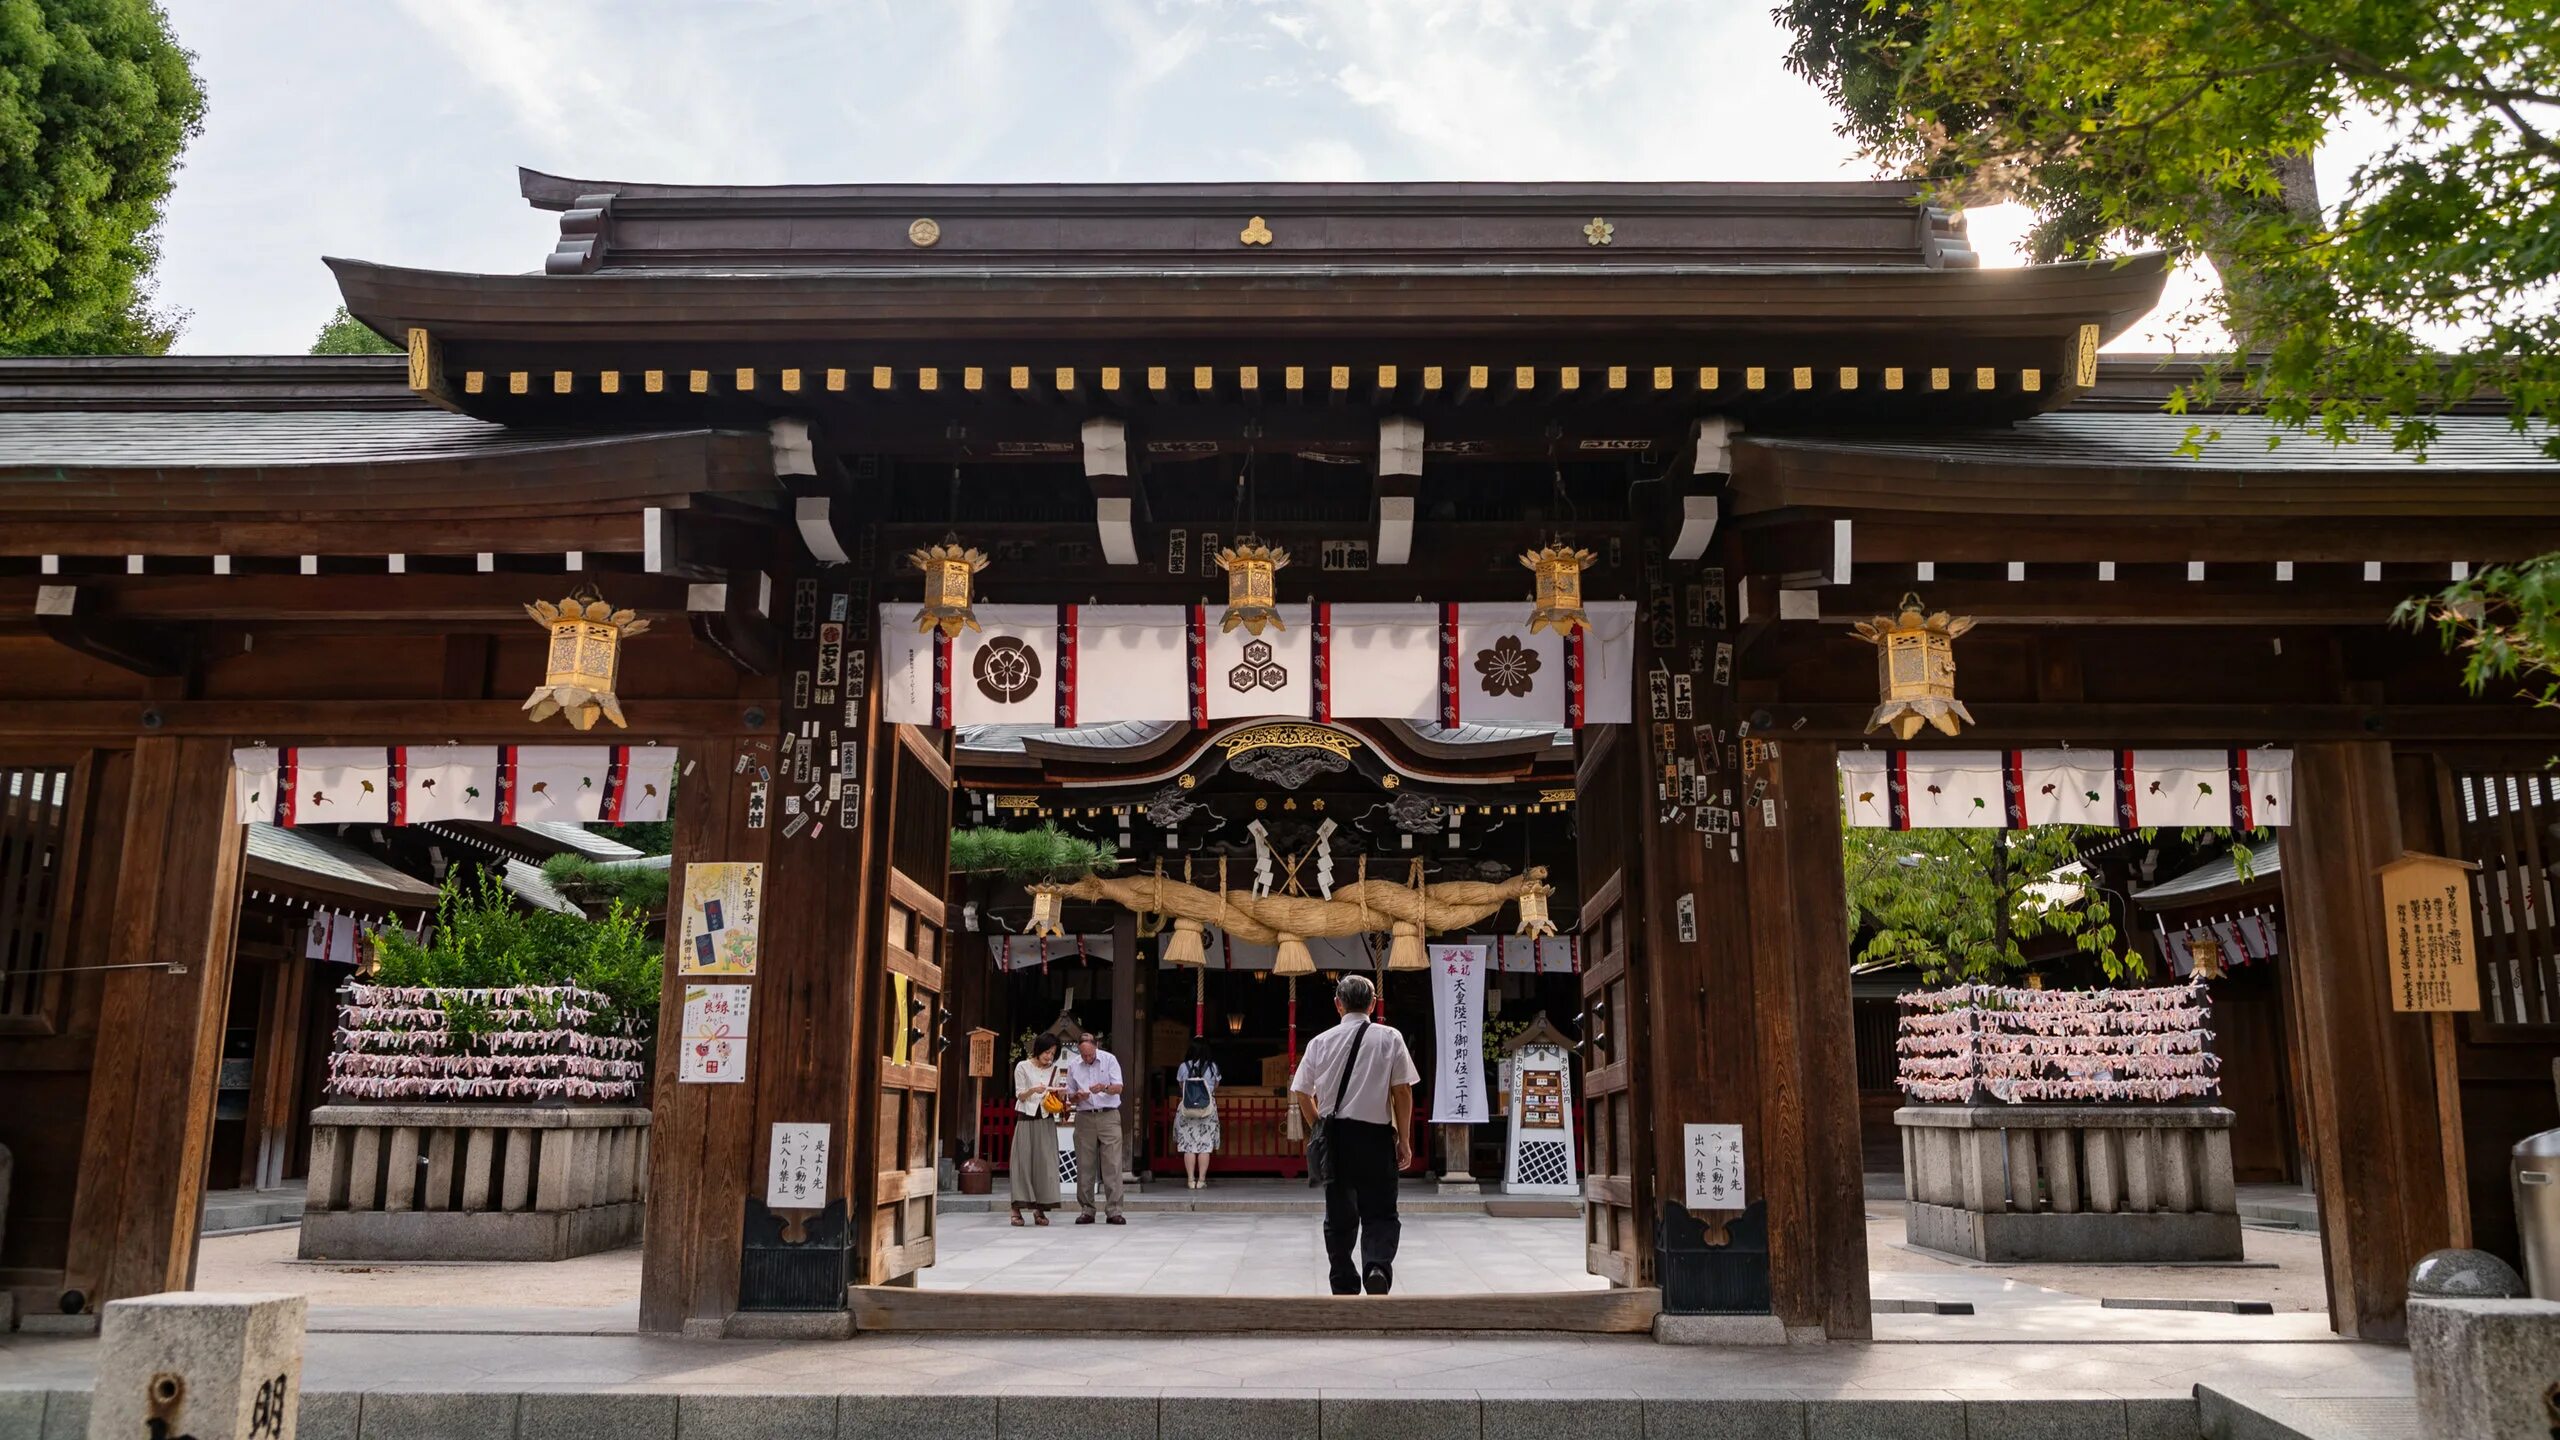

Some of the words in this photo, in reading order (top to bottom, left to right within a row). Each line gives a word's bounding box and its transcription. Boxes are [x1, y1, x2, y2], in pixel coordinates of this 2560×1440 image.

[1453, 979, 1469, 1118] 天皇陛下御即位三十年
[777, 1133, 791, 1193] 出入り禁止
[813, 1140, 825, 1189] 是より先
[1694, 1134, 1707, 1195] 出入り禁止
[1730, 1141, 1742, 1190] 是より先
